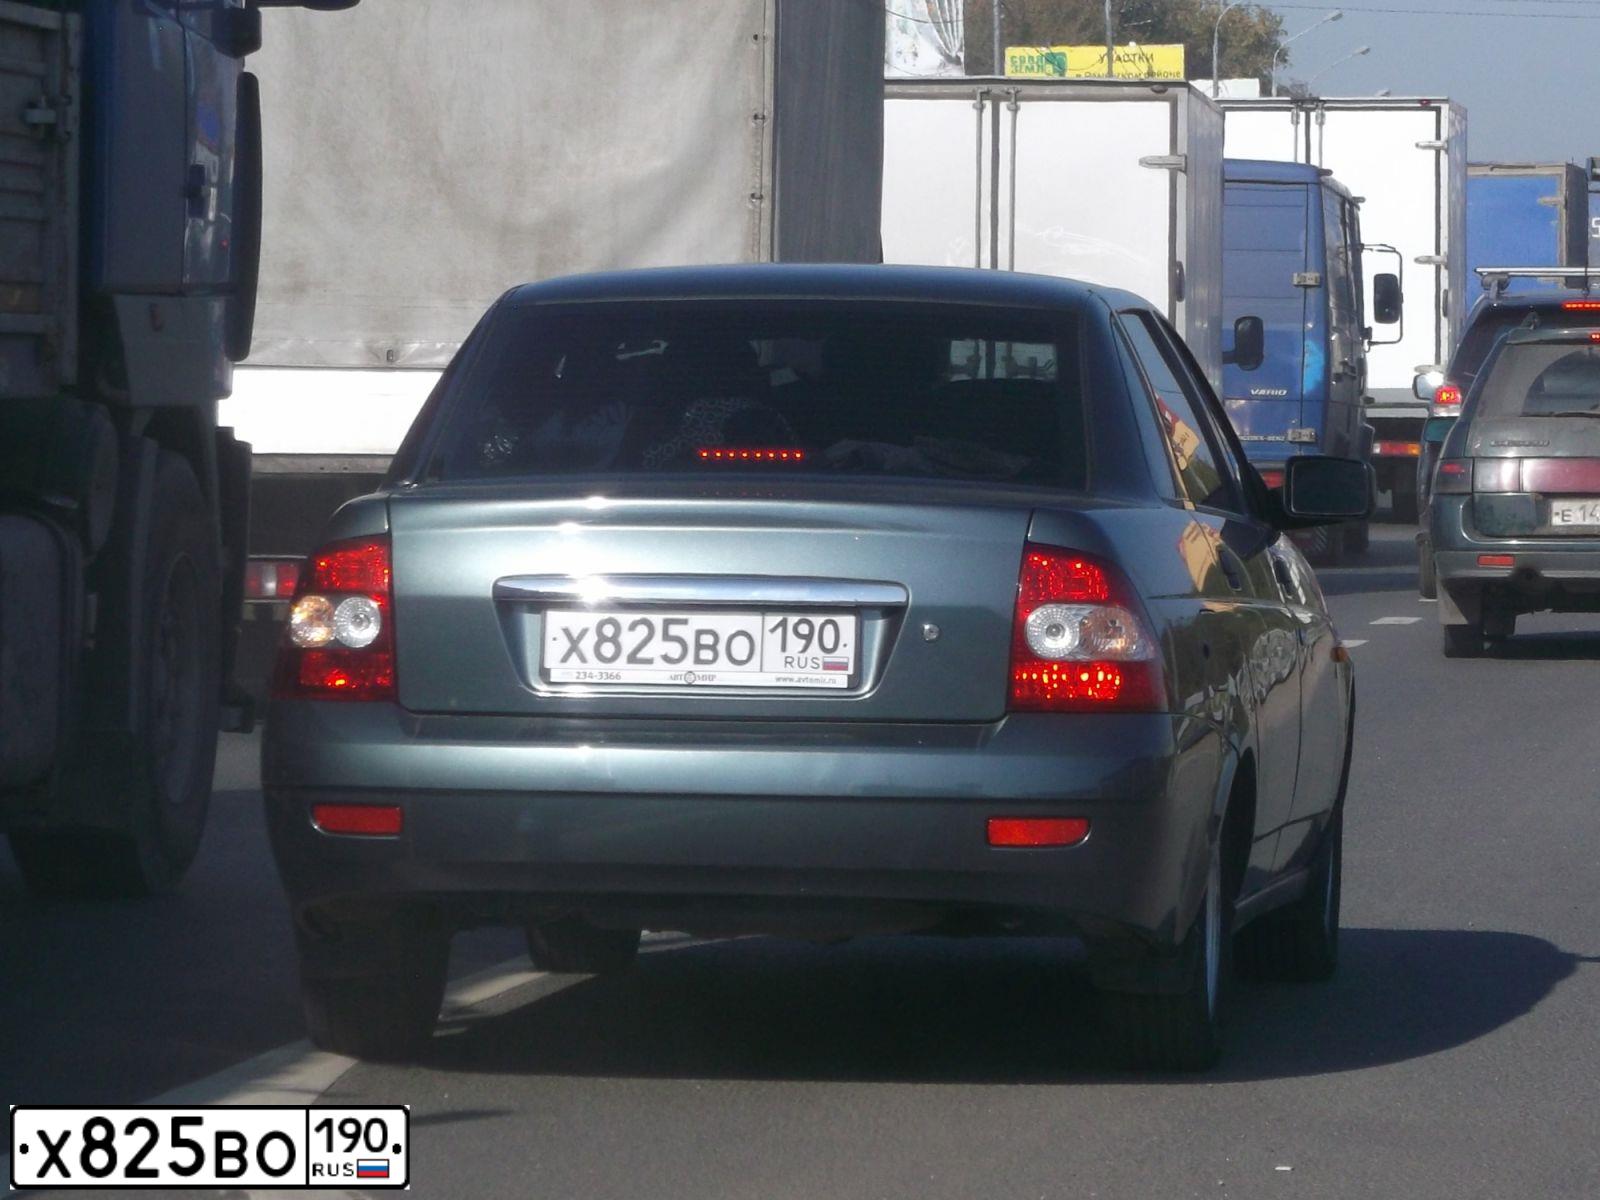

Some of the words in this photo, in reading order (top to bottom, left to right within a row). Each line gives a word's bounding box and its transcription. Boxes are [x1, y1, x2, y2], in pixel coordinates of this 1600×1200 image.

[1099, 52, 1154, 64] УАСТКИ
[768, 616, 841, 655] 190
[784, 655, 821, 671] RUS
[575, 671, 622, 681] 234-3366
